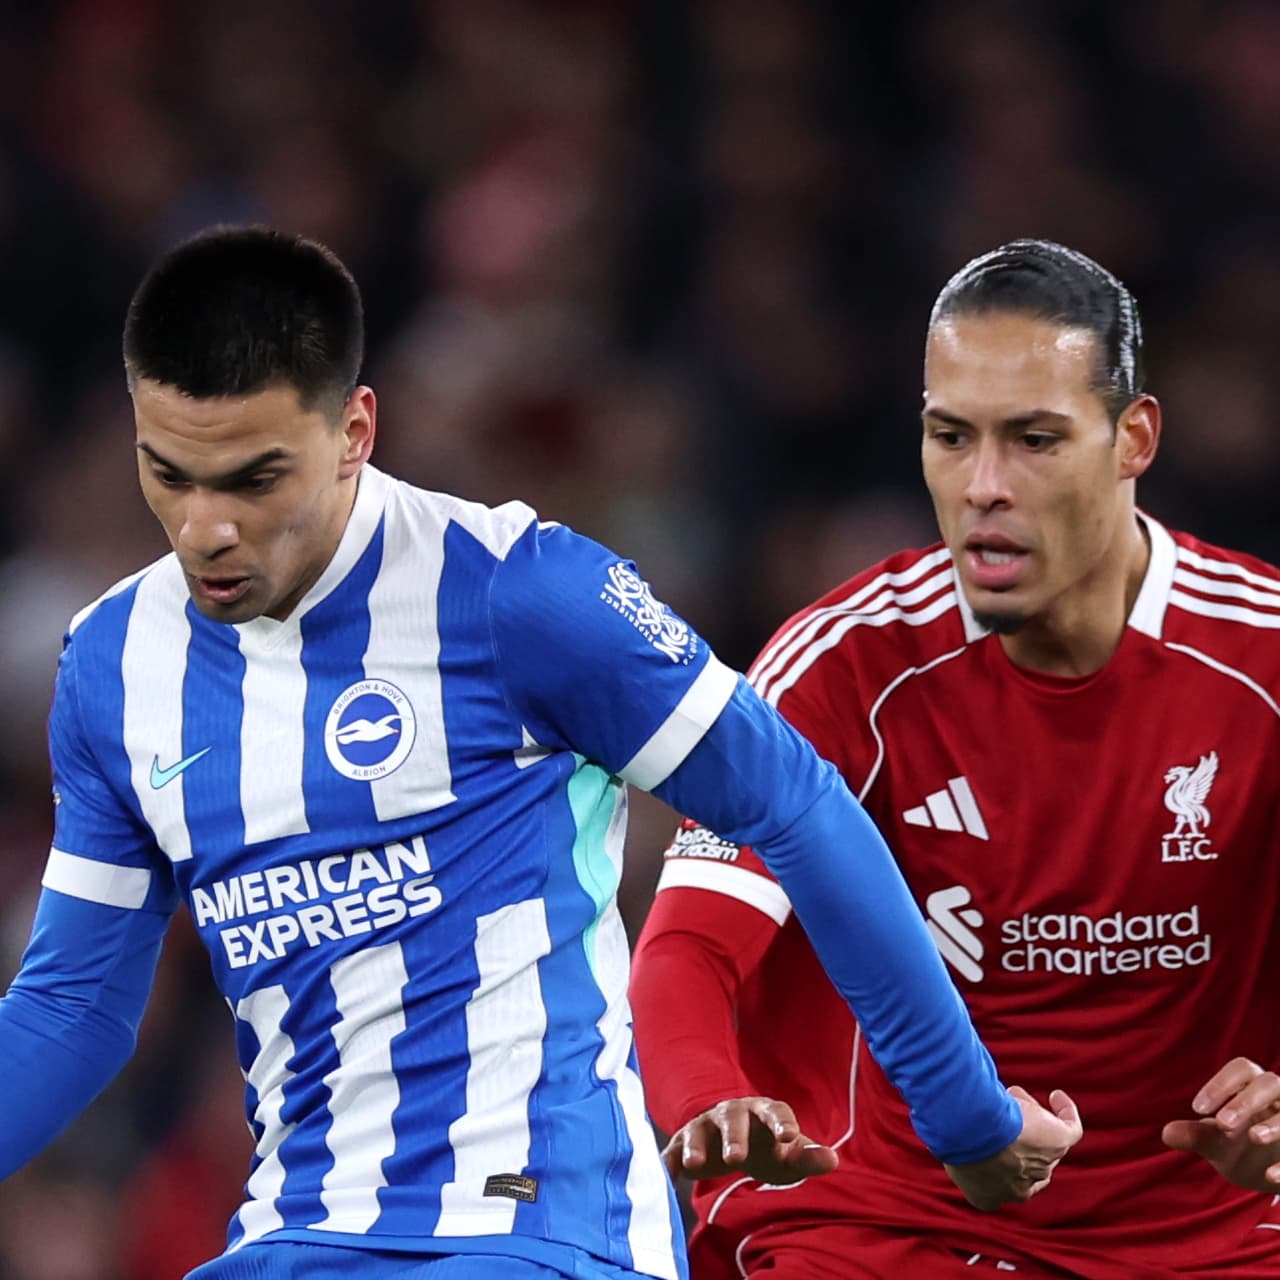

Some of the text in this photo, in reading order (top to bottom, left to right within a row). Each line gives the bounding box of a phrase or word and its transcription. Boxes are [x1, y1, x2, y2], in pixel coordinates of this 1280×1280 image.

[333, 683, 371, 715] BRIGHTON
[382, 685, 404, 705] HOVE
[352, 765, 387, 777] ALBION
[191, 835, 431, 928] AMERICAN
[220, 875, 443, 969] EXPRESS
[1001, 904, 1199, 944] standard
[1001, 934, 1211, 976] chartered
